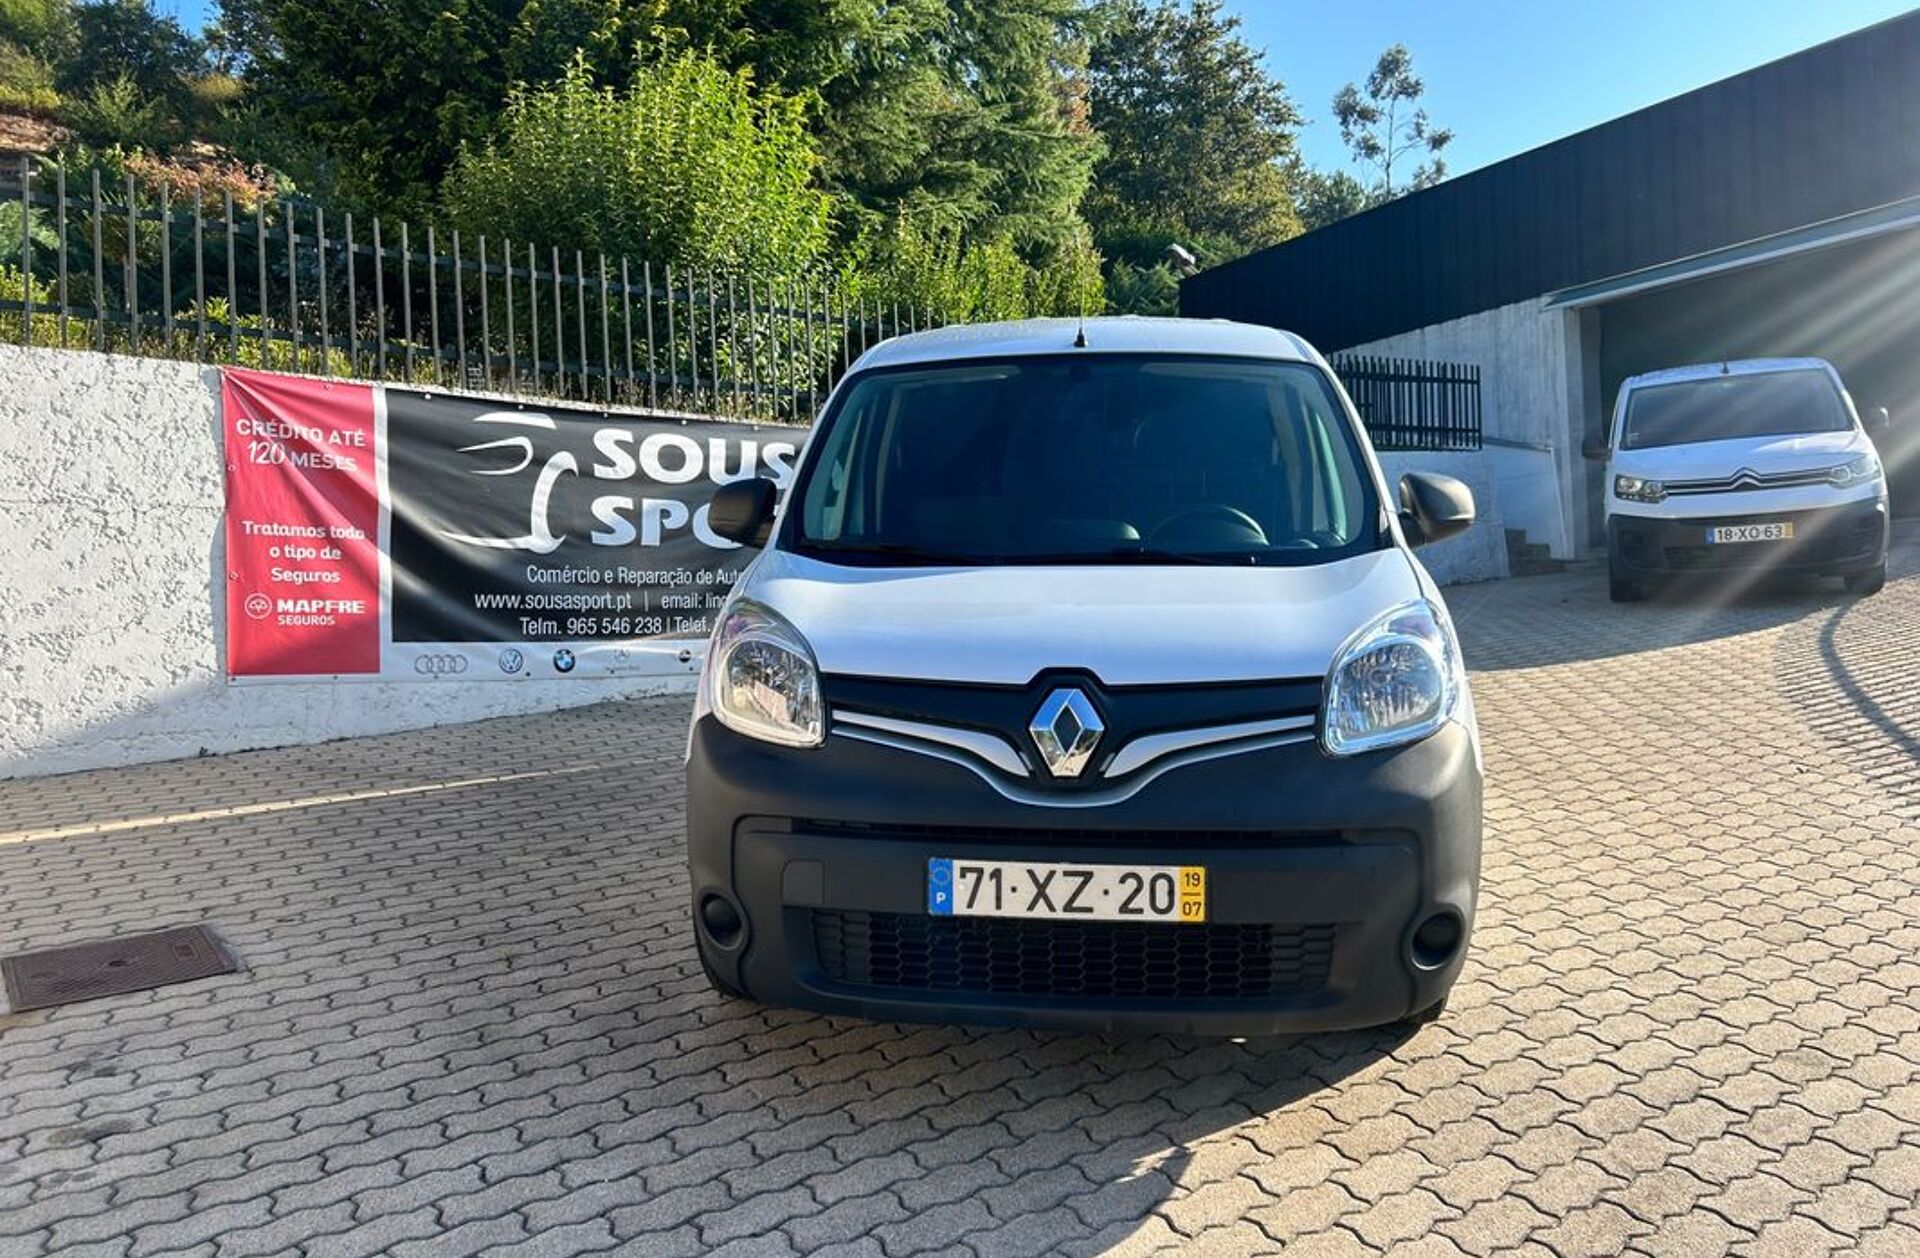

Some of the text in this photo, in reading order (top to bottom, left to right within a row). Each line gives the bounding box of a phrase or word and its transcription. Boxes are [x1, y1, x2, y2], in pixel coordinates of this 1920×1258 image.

[236, 418, 366, 447] CRÉDITO ATÉ
[247, 441, 358, 472] 120 MESES
[242, 520, 326, 539] Tratamos
[269, 545, 341, 561] o tipo de
[271, 567, 341, 584] Seguros
[527, 564, 600, 584] Comércio
[604, 570, 614, 584] e
[617, 566, 692, 588] Reparação
[696, 568, 712, 585] de
[277, 599, 366, 614] MAPFRE
[474, 591, 632, 613] www.sousasport.pt
[661, 592, 702, 609] email:
[278, 615, 336, 626] SEGUROS
[520, 617, 562, 635] Telm.
[567, 617, 597, 635] 965
[601, 617, 631, 635] 546
[635, 617, 662, 635] 238
[674, 616, 711, 633] Telef.
[1184, 872, 1201, 887] 19
[936, 892, 946, 904] P
[1182, 901, 1202, 916] 07
